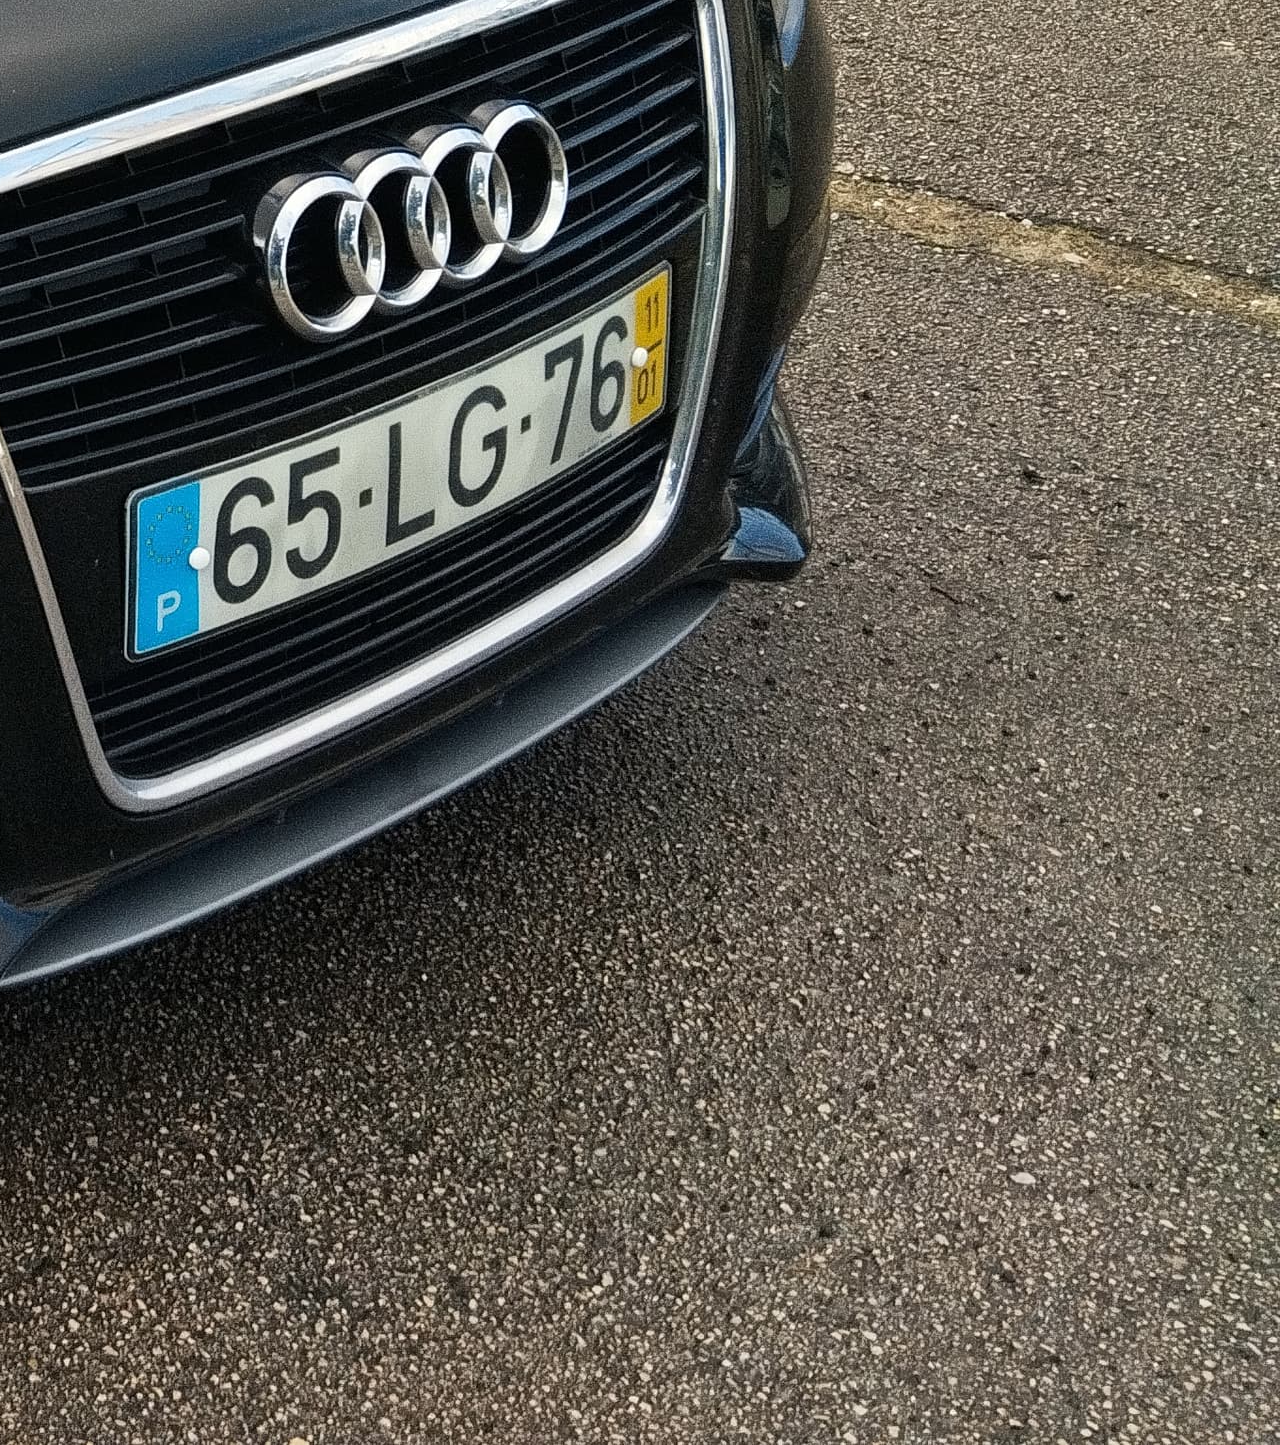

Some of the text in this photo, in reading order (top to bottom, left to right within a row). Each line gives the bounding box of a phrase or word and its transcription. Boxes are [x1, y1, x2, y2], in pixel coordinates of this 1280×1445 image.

[644, 292, 661, 333] 11
[636, 363, 657, 405] 01
[156, 590, 181, 632] P
